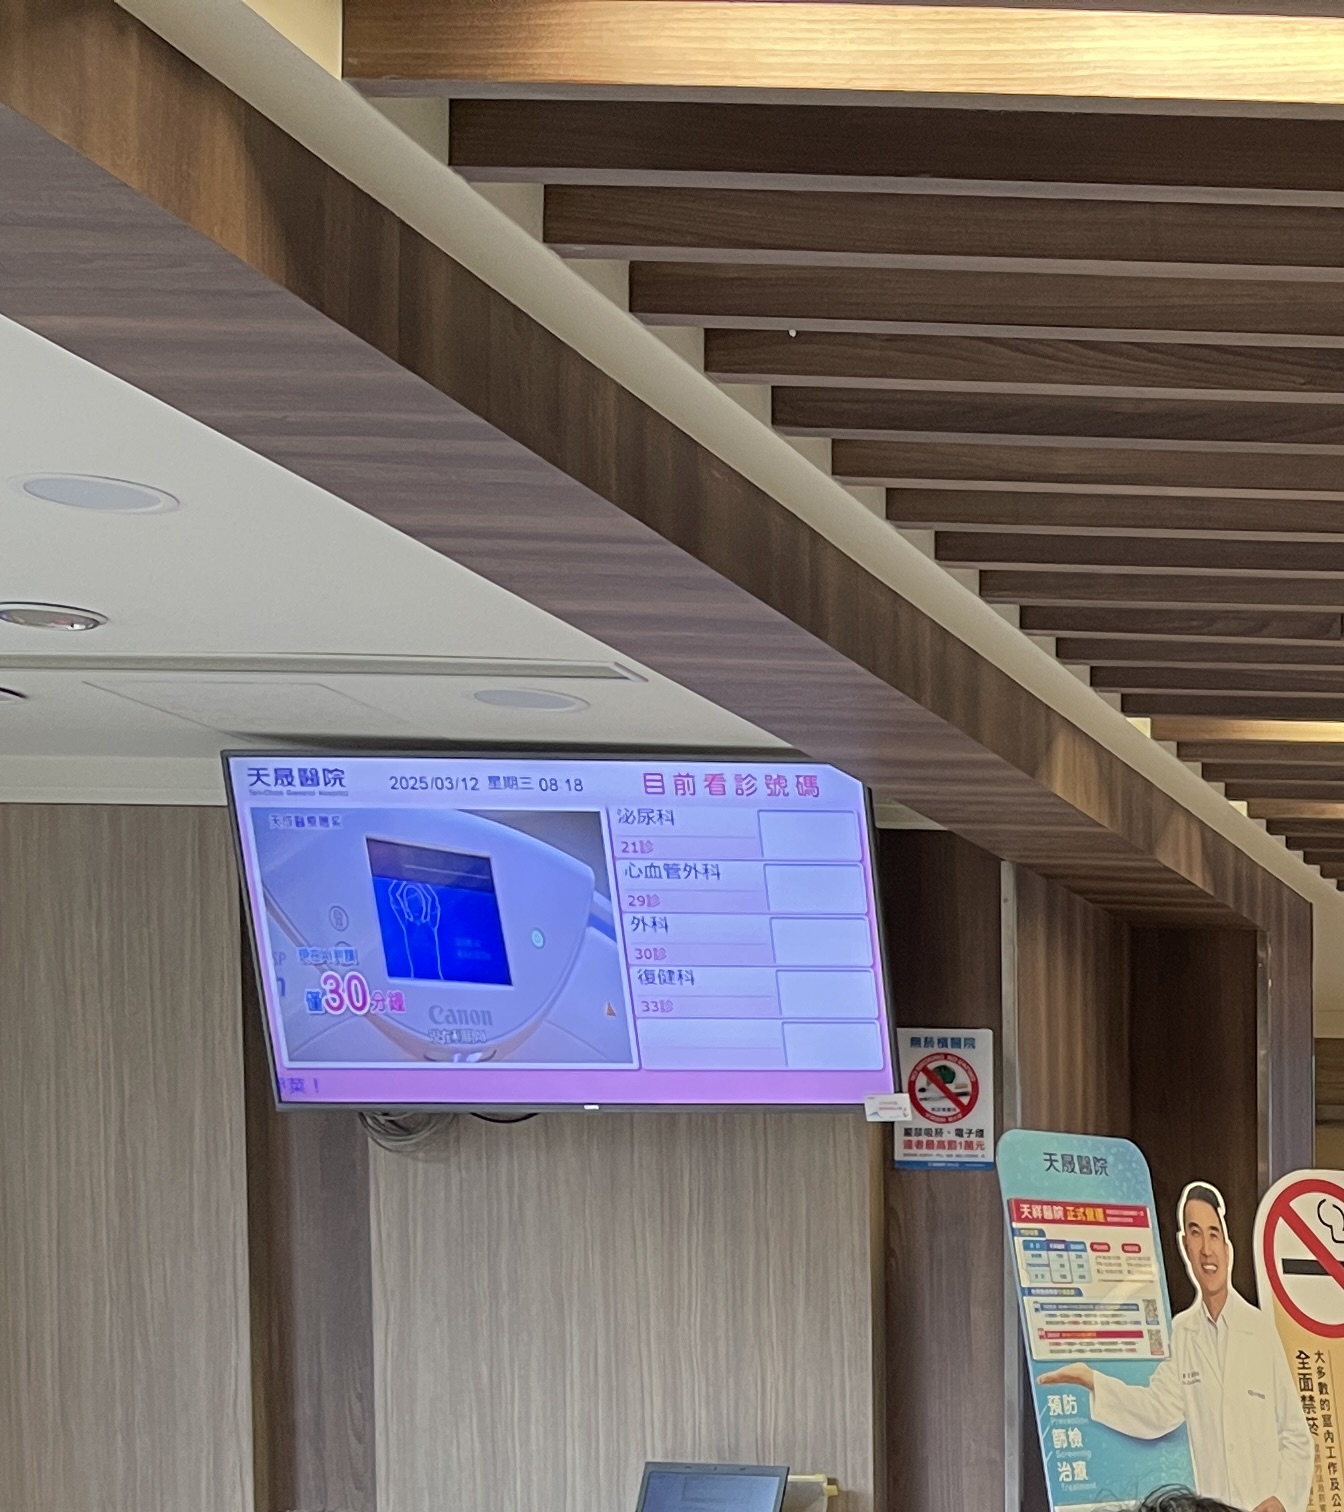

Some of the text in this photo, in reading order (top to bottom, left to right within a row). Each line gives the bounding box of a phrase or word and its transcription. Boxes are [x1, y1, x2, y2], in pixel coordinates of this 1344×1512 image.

[247, 767, 347, 789] 天晟醫院
[388, 775, 480, 792] 2025/03/12
[486, 775, 534, 790] 星期三
[642, 772, 821, 798] 目前看診號碼
[616, 807, 675, 826] 泌尿科
[623, 862, 722, 881] 心血管外科
[630, 915, 670, 934] 外科
[636, 968, 696, 987] 復健科
[427, 1004, 494, 1027] Canon
[1043, 1151, 1109, 1177] 天晟醫院
[1047, 1393, 1078, 1417] 預防
